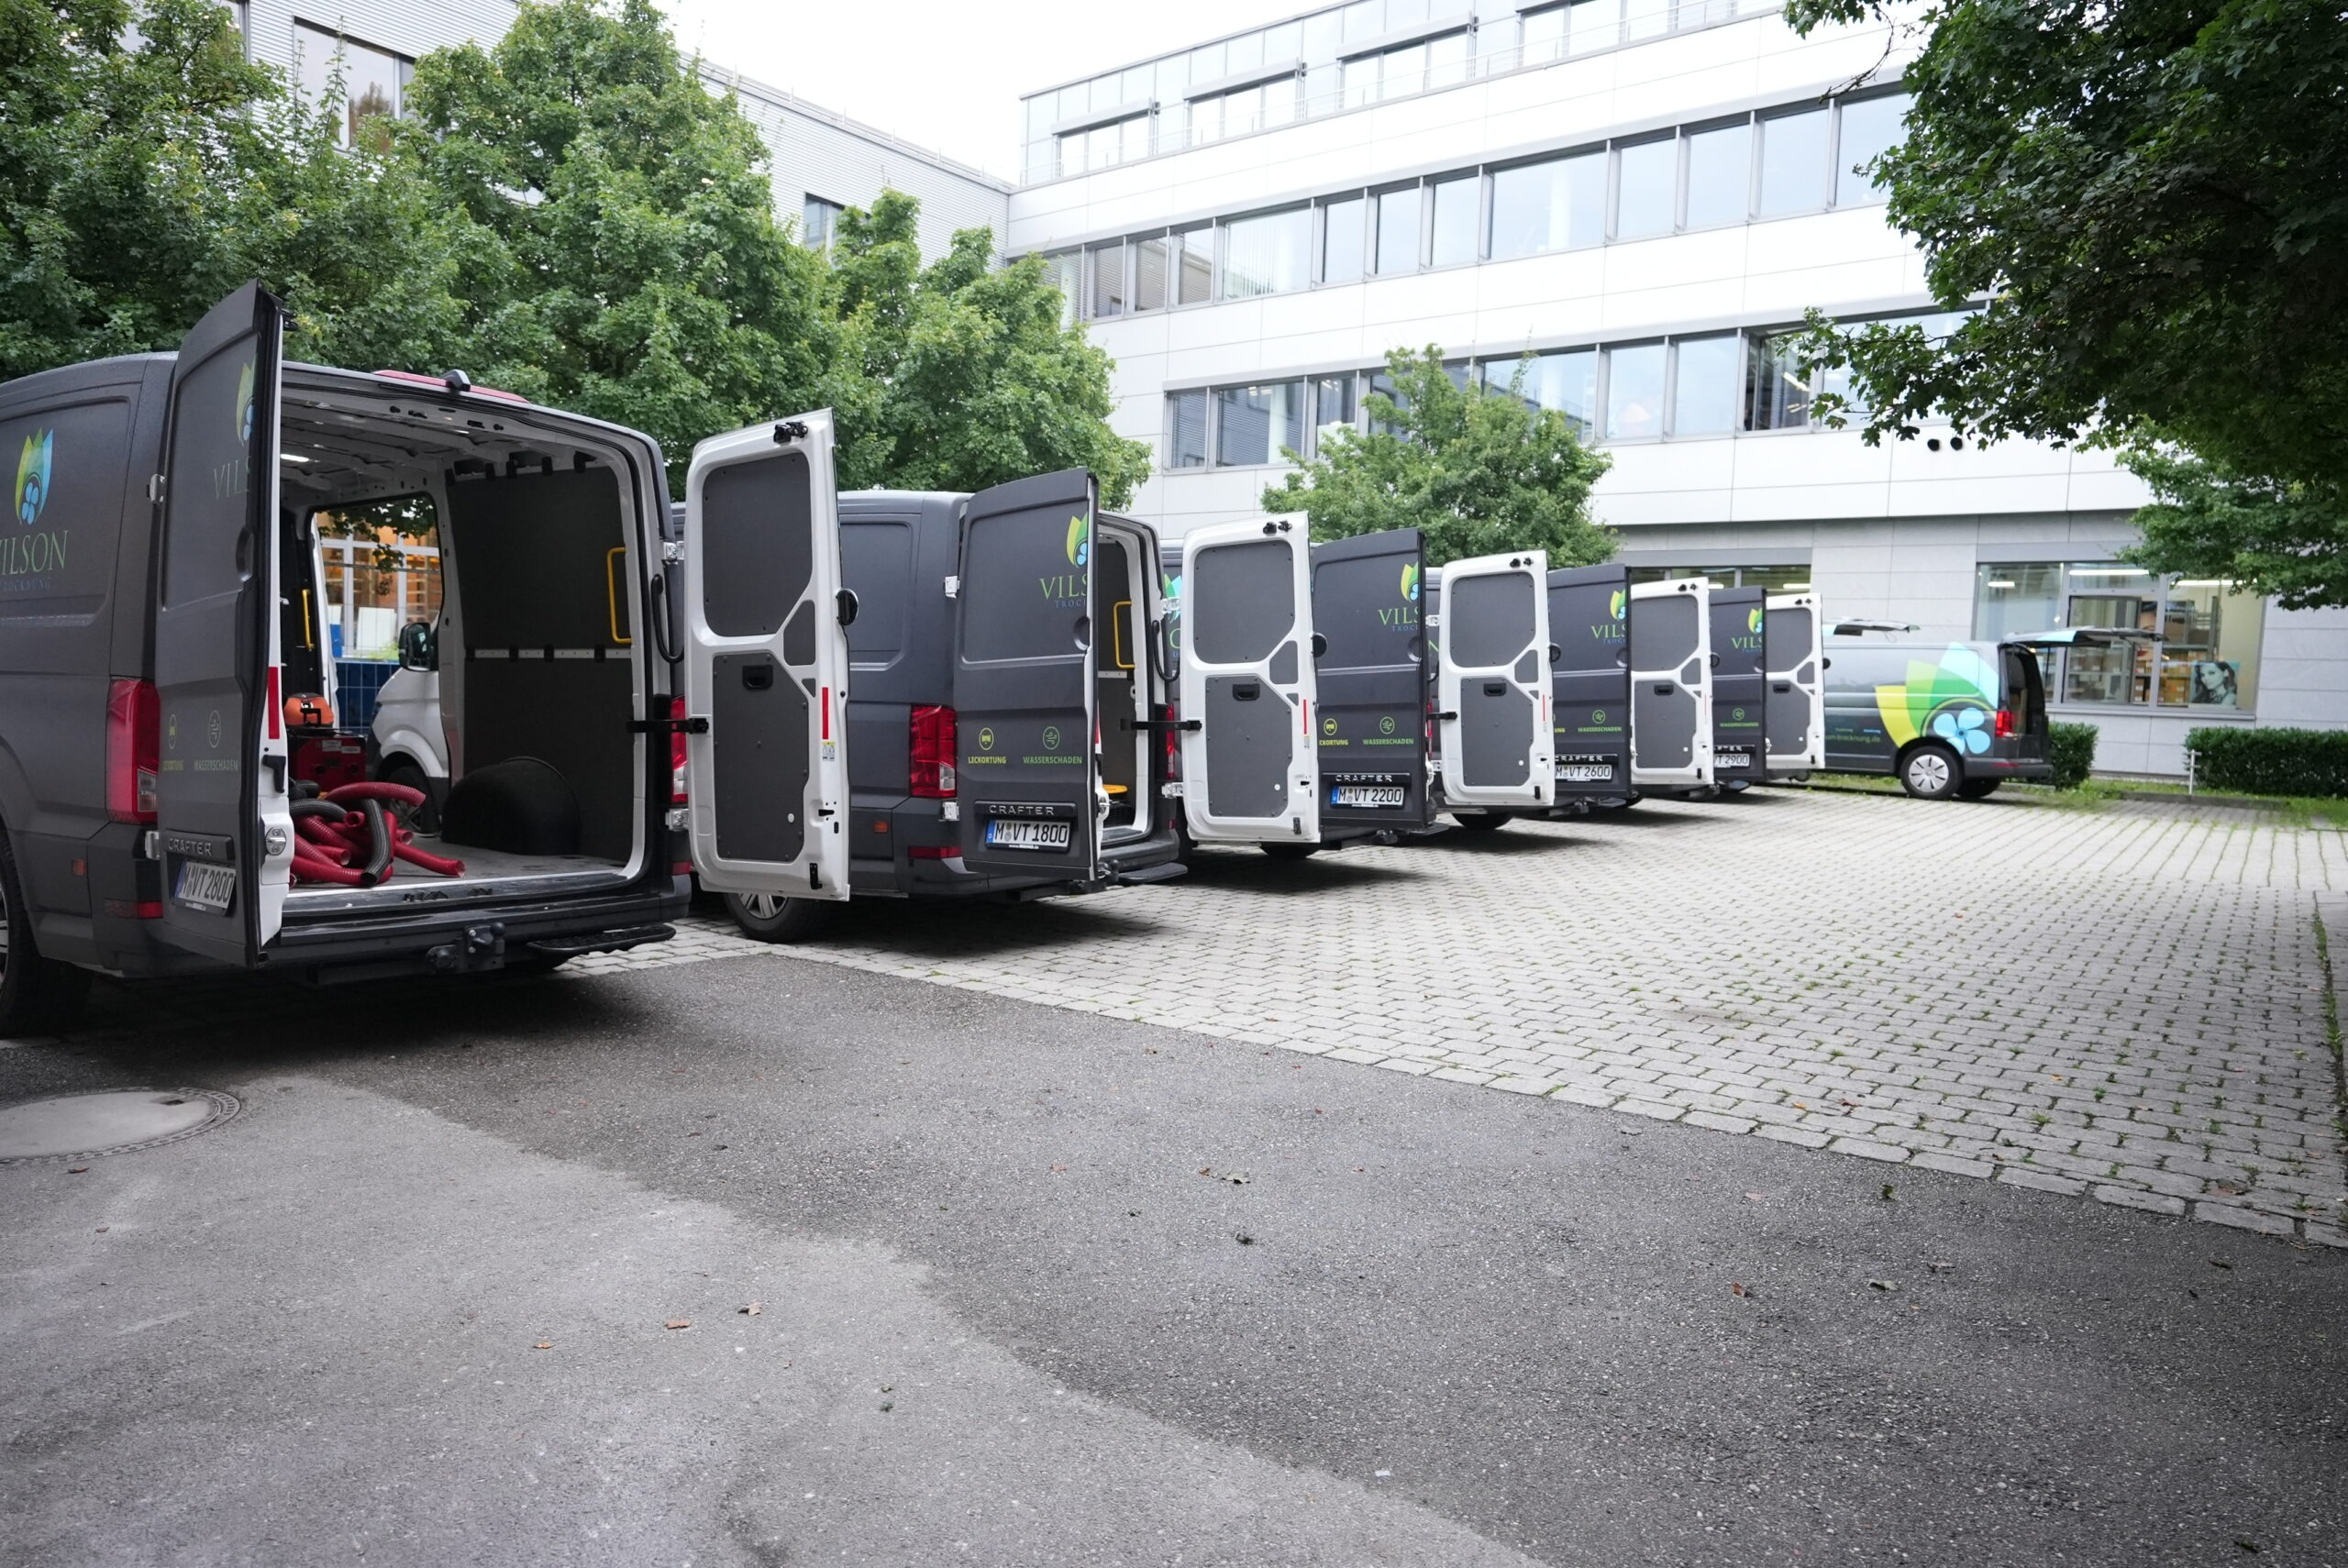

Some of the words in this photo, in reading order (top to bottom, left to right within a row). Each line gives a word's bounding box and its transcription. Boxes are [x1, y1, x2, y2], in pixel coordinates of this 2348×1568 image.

[0, 530, 69, 576] ILSON
[1724, 755, 1748, 765] 2900
[1569, 766, 1581, 778] VT
[1584, 766, 1611, 778] 2600
[1338, 789, 1347, 802] M
[1355, 788, 1369, 802] VT
[1371, 789, 1402, 803] 2200
[989, 805, 1055, 815] CRAFTER
[994, 823, 1005, 841] M
[1013, 823, 1031, 842] VT
[1032, 823, 1068, 843] 1800
[168, 837, 213, 856] CRAFTER
[204, 869, 236, 904] 2800
